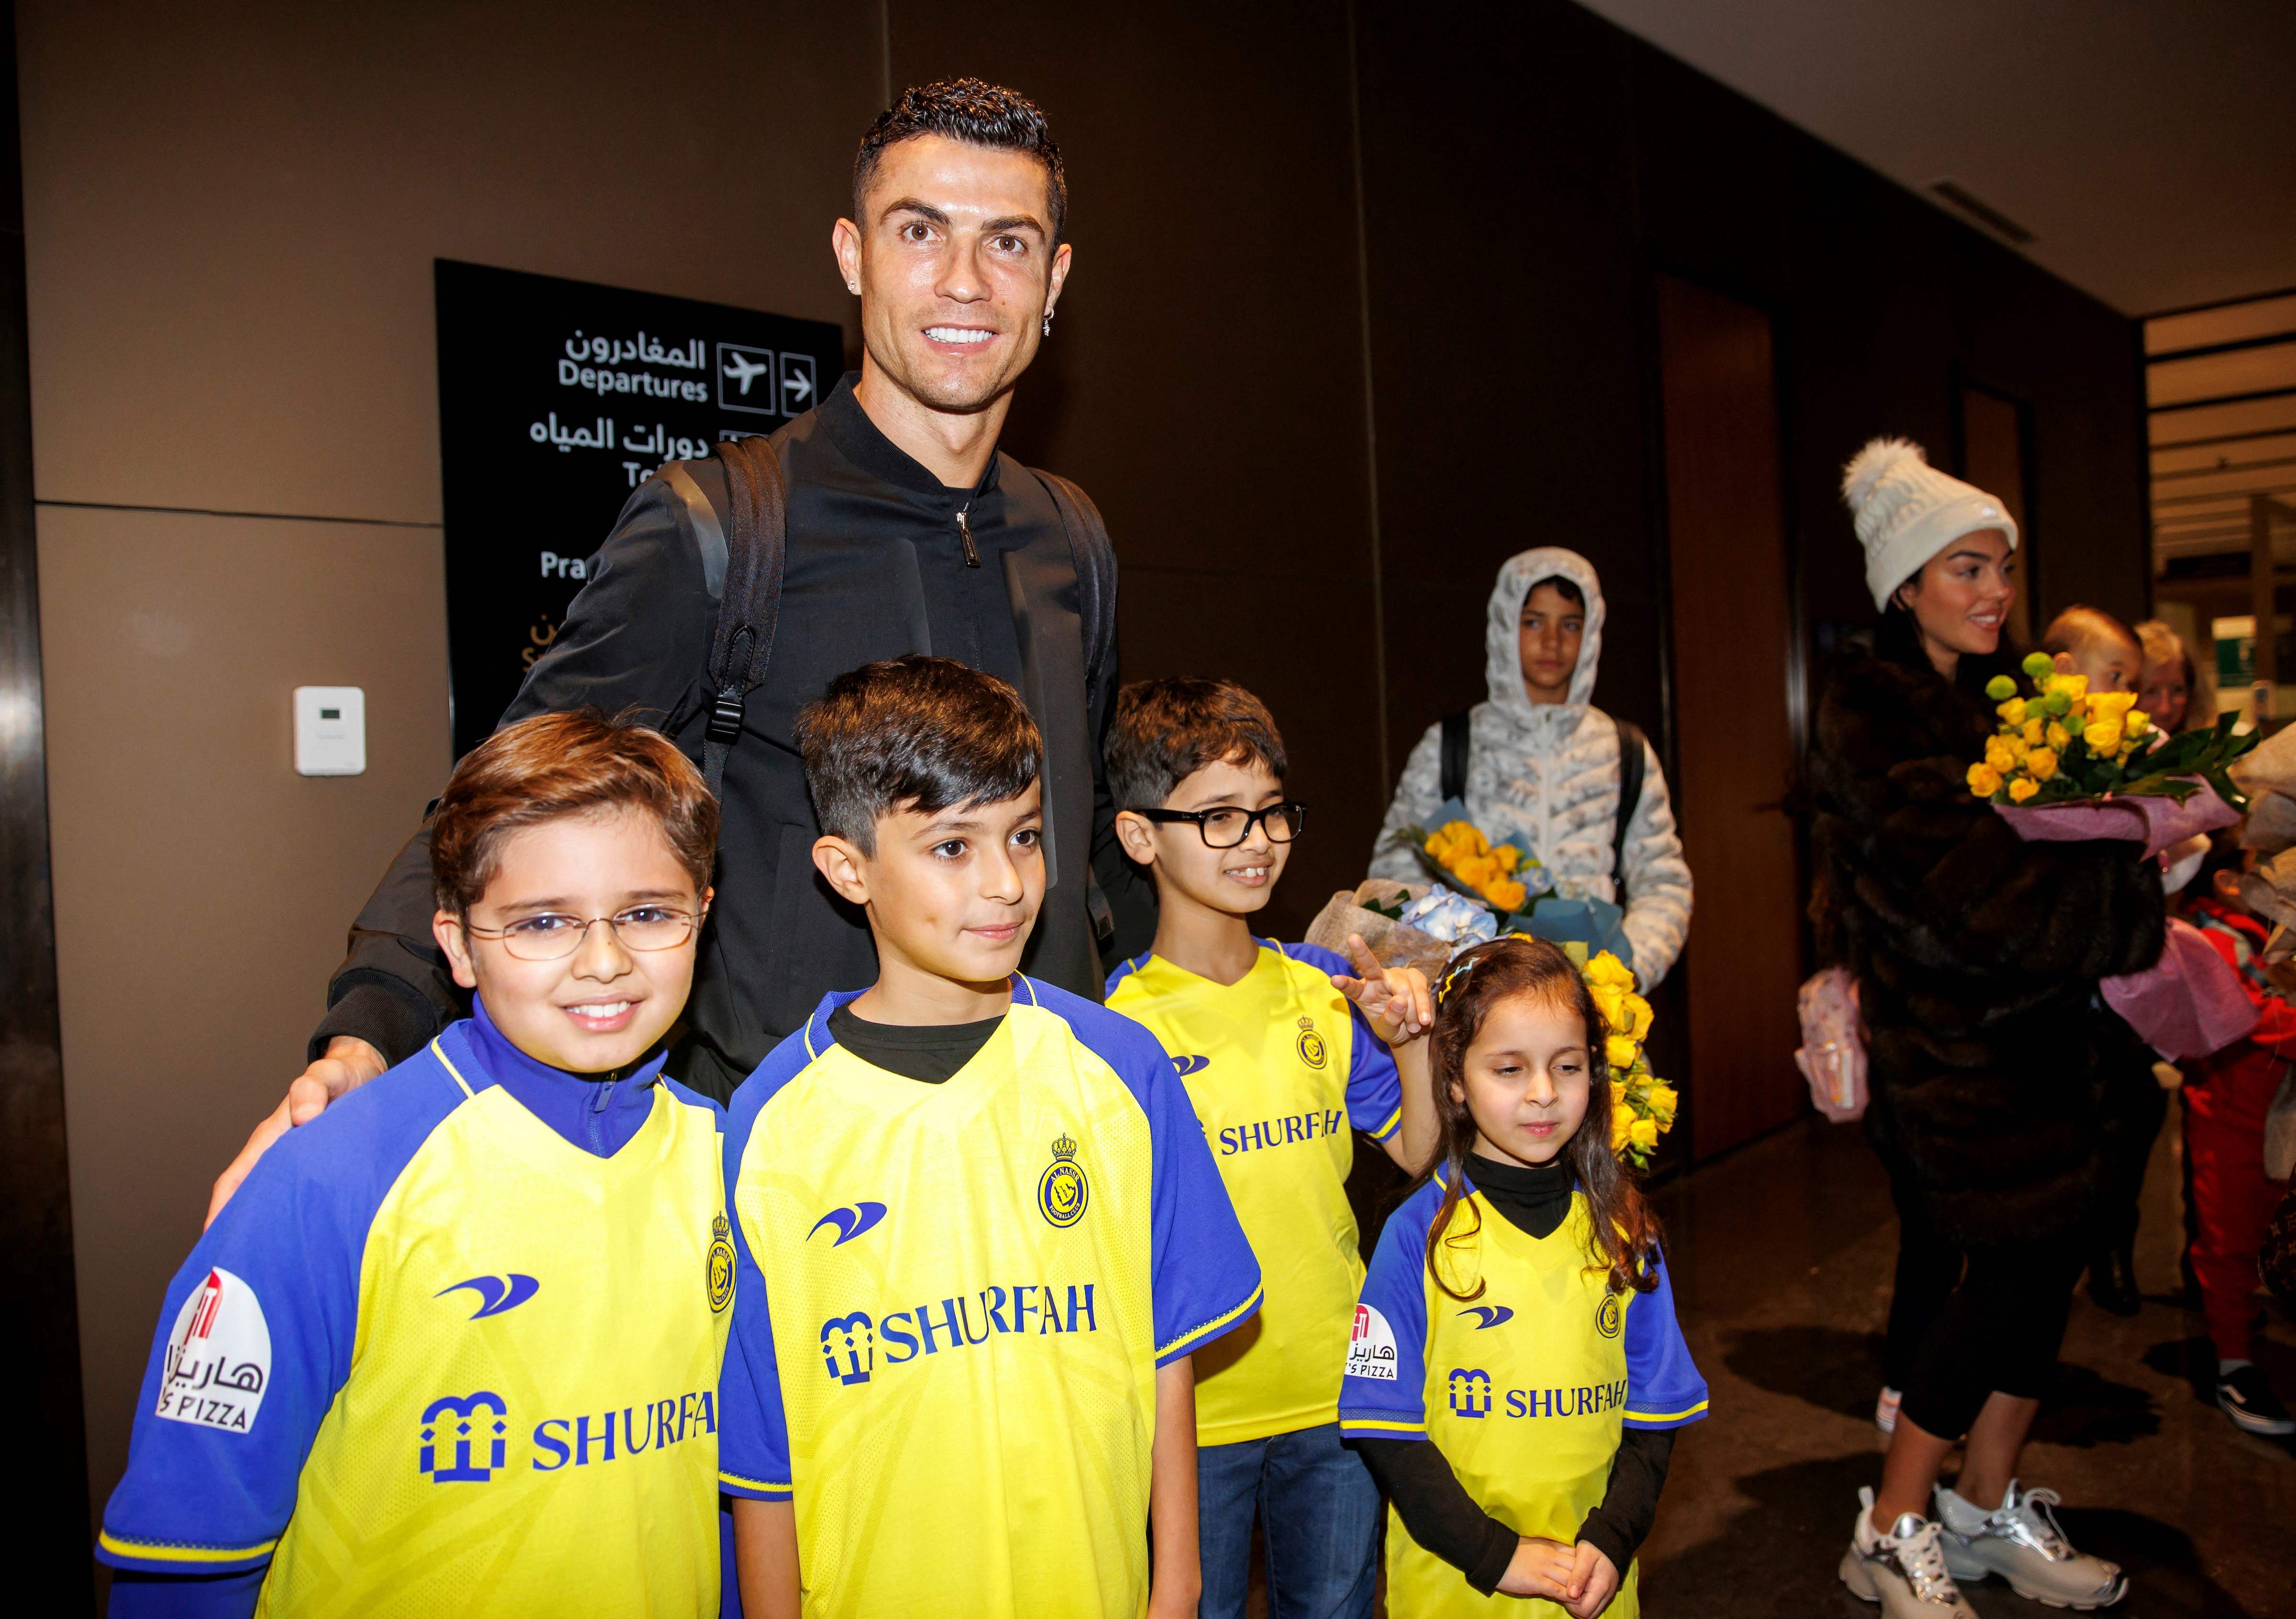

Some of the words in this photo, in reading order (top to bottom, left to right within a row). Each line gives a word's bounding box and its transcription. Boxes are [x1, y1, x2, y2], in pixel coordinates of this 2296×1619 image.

[565, 330, 706, 370] المغادرون
[558, 359, 708, 403] Departures
[530, 411, 614, 452] المياه
[623, 423, 709, 462] دورات
[541, 551, 586, 580] Pra
[1050, 1171, 1060, 1183] AL
[1060, 1167, 1080, 1182] NASSR
[1049, 1205, 1071, 1219] FOOTBALL
[1071, 1202, 1081, 1216] CLUB
[879, 1283, 1097, 1364] SHURFAH
[1360, 1365, 1394, 1378] PIZZA
[177, 1396, 245, 1429] PIZZA
[1506, 1379, 1627, 1418] SHURFAH
[532, 1391, 717, 1471] SHURFA
